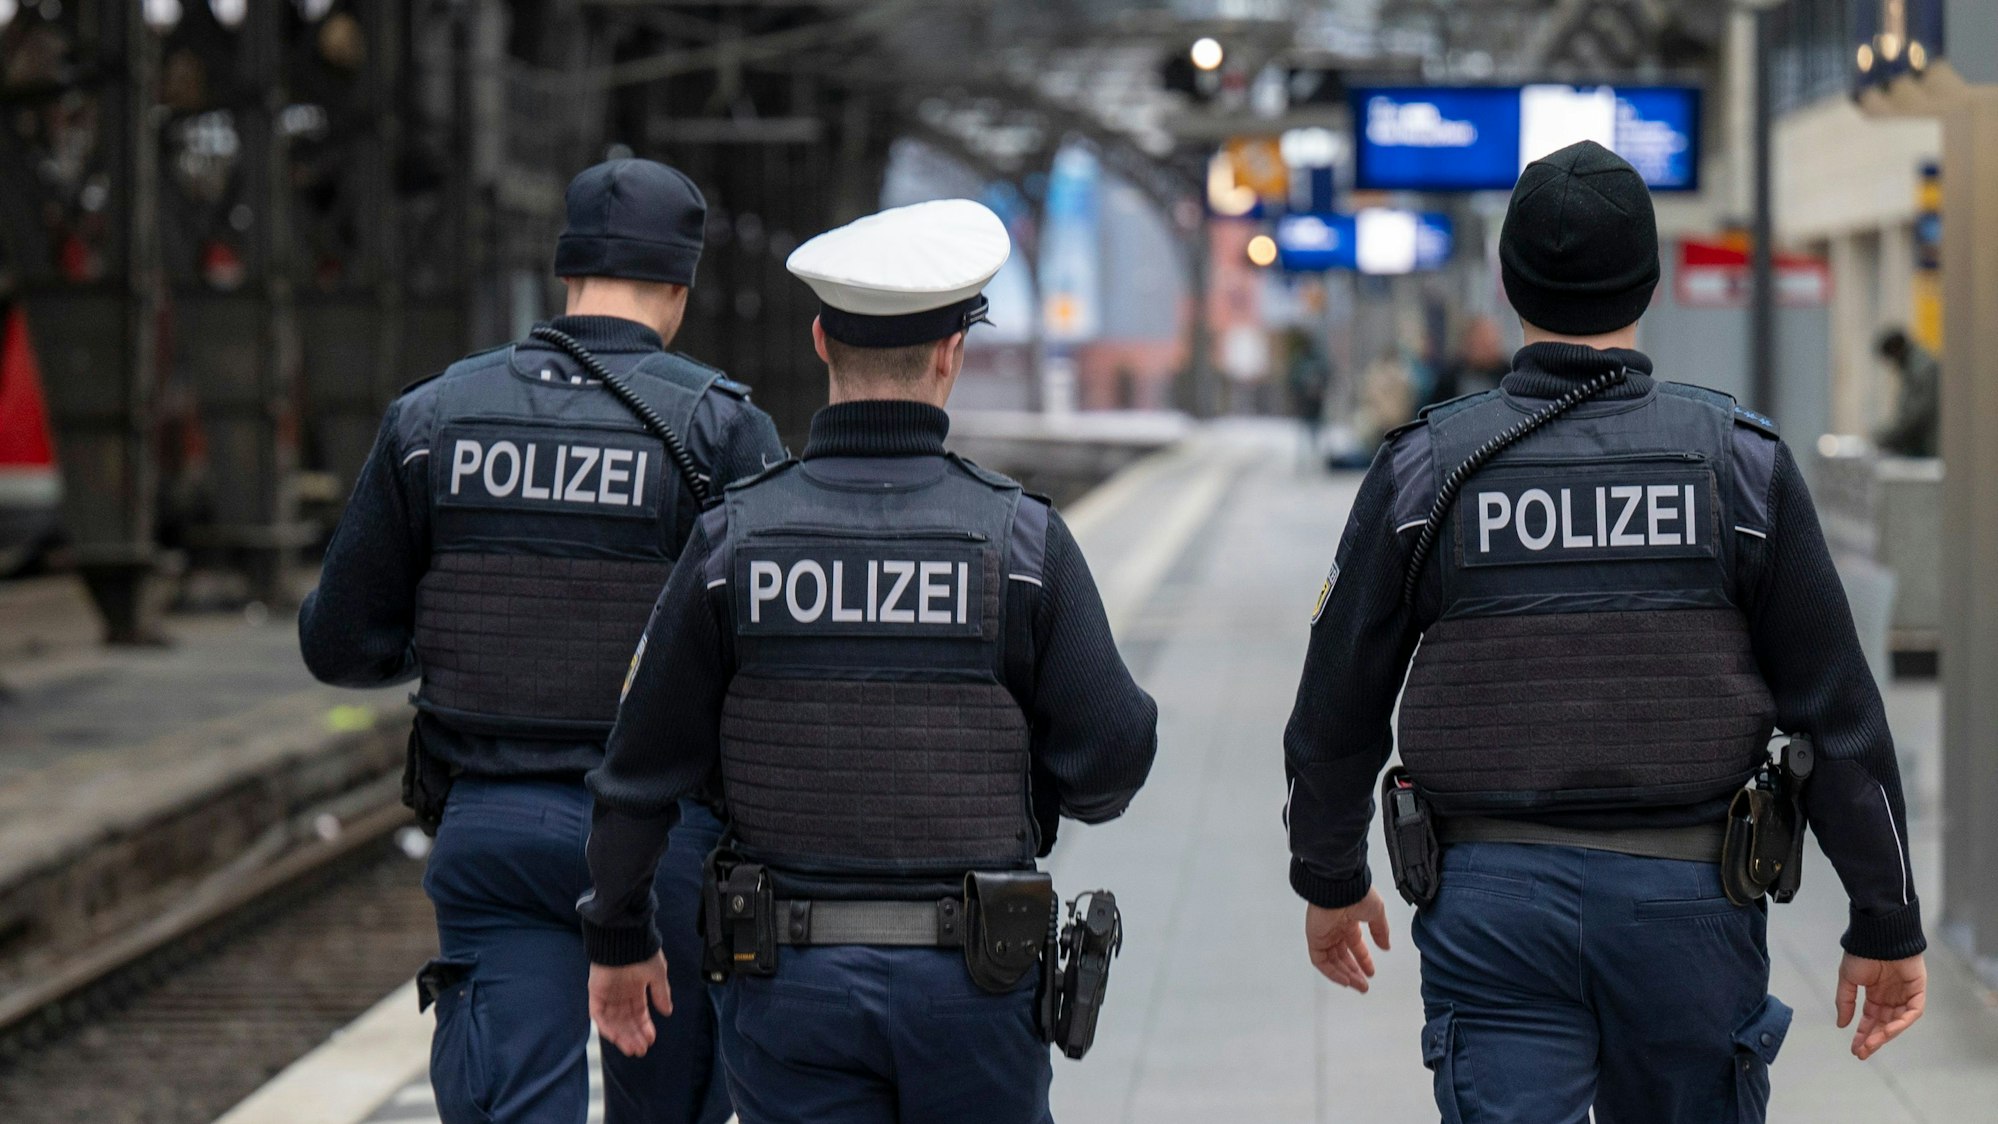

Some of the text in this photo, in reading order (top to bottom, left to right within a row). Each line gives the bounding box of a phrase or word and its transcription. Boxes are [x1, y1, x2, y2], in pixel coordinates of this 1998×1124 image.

[450, 439, 648, 506] POLIZEI
[1478, 484, 1696, 553] POLIZEI
[750, 559, 968, 624] POLIZEI
